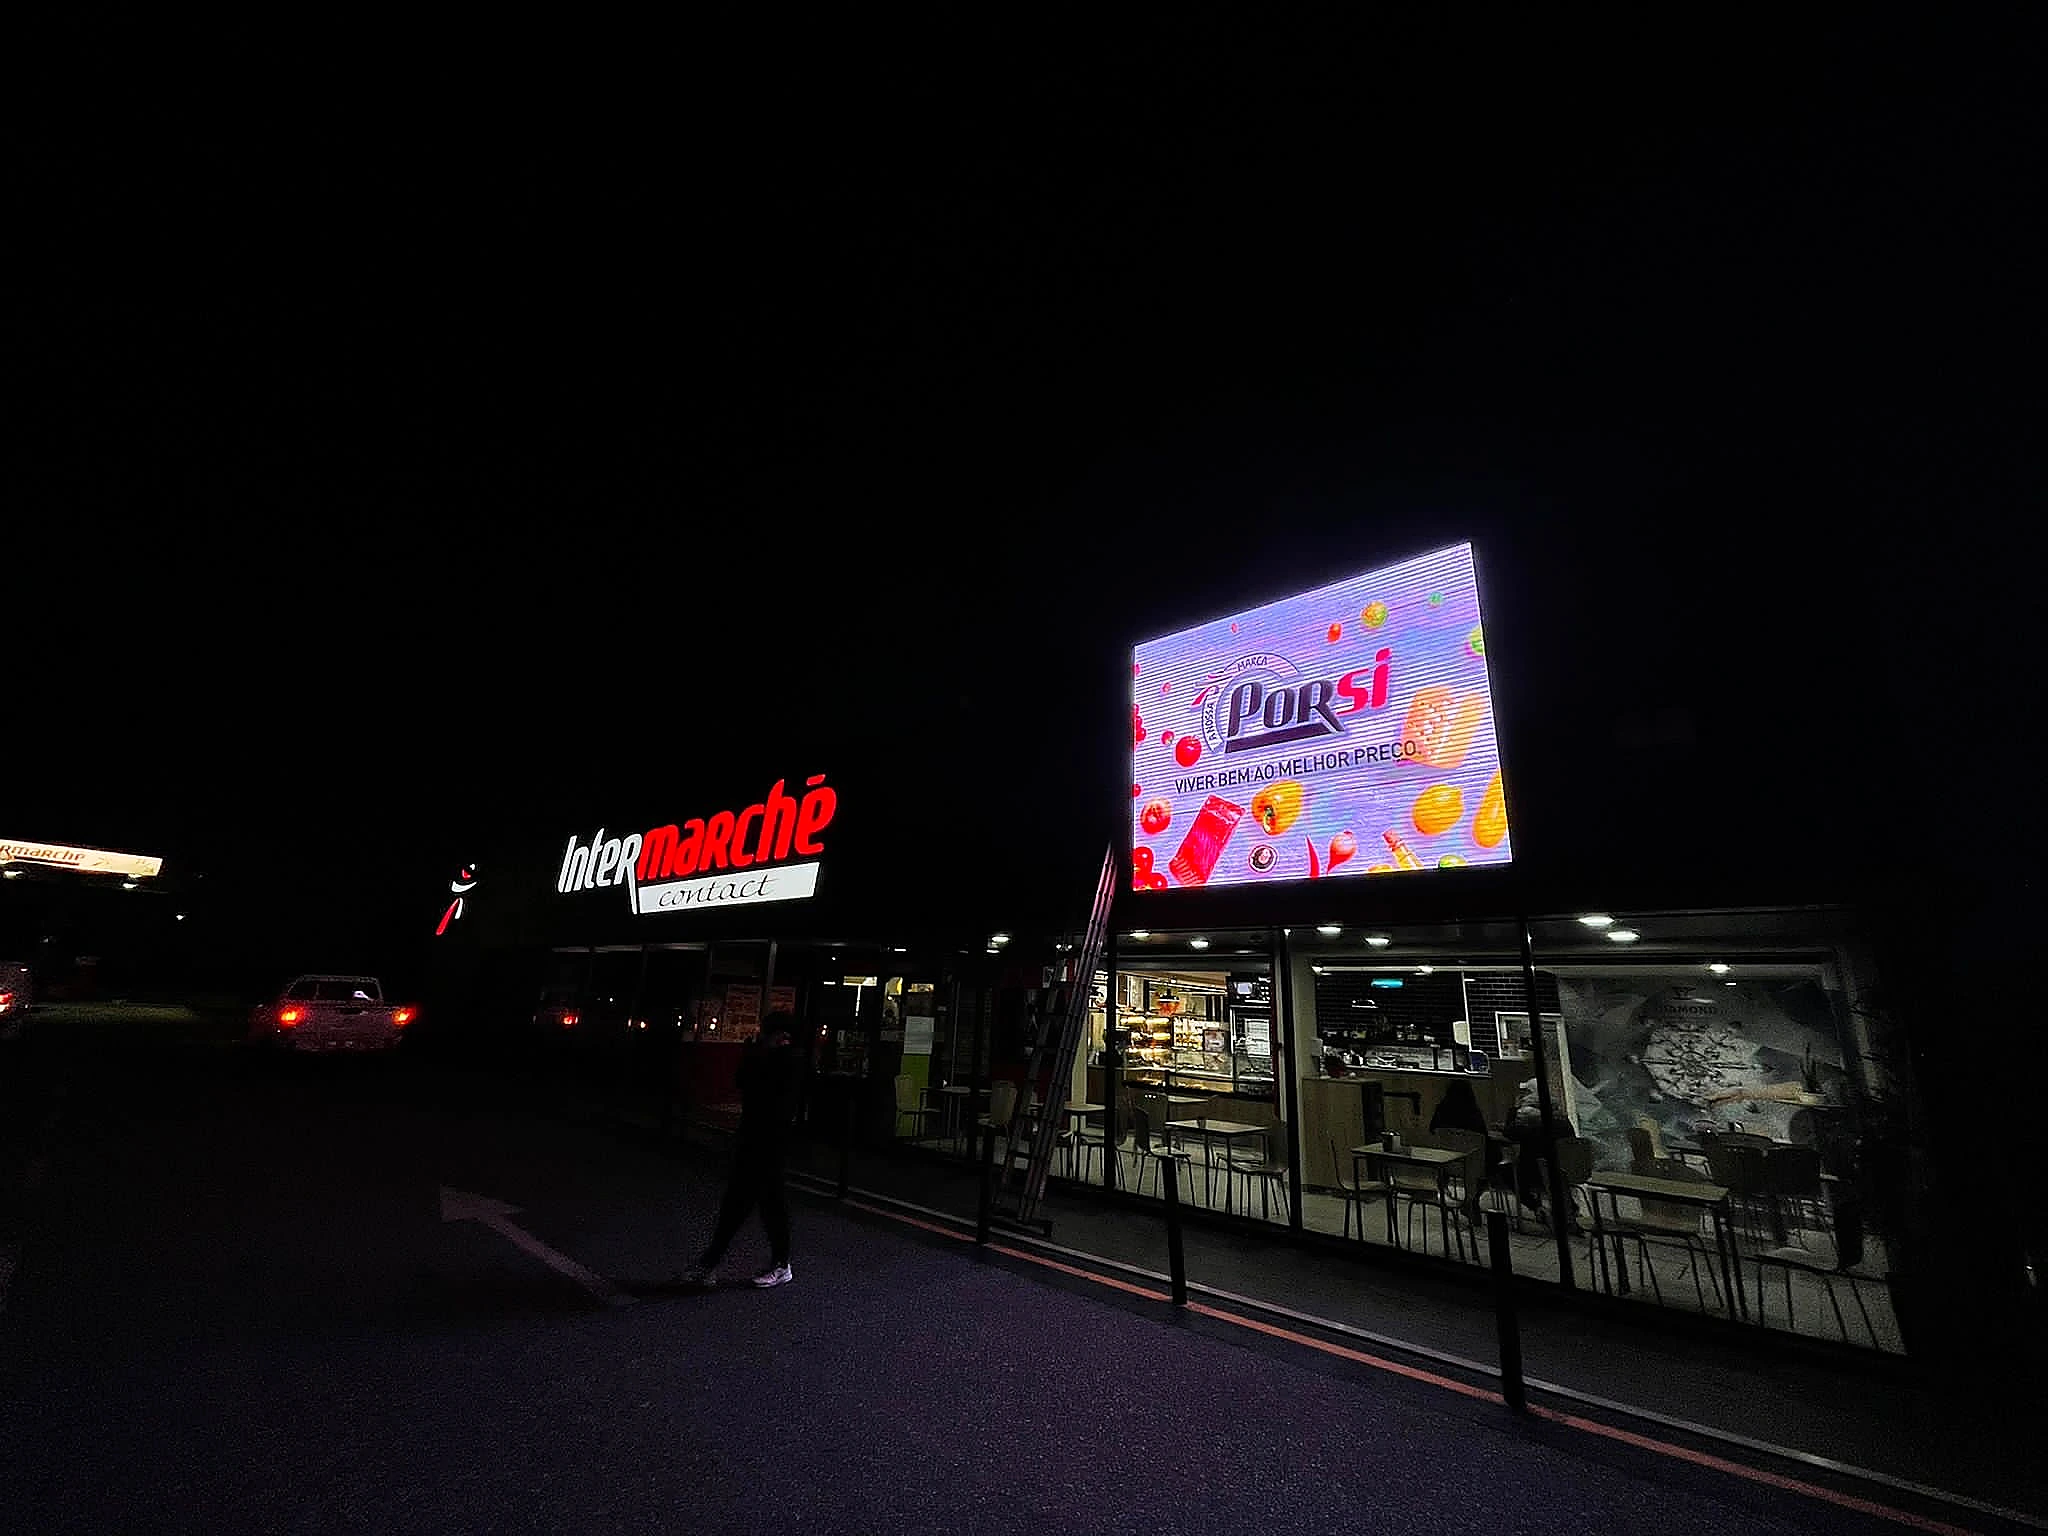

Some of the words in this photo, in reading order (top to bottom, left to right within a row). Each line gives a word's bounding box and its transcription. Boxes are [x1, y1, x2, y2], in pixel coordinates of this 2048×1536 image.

[1237, 656, 1268, 671] MARCA
[1175, 774, 1214, 794] VIVER
[1218, 769, 1251, 788] BEM
[1254, 765, 1275, 782] AO
[1281, 751, 1350, 777] MELHOR
[658, 875, 780, 907] contact
